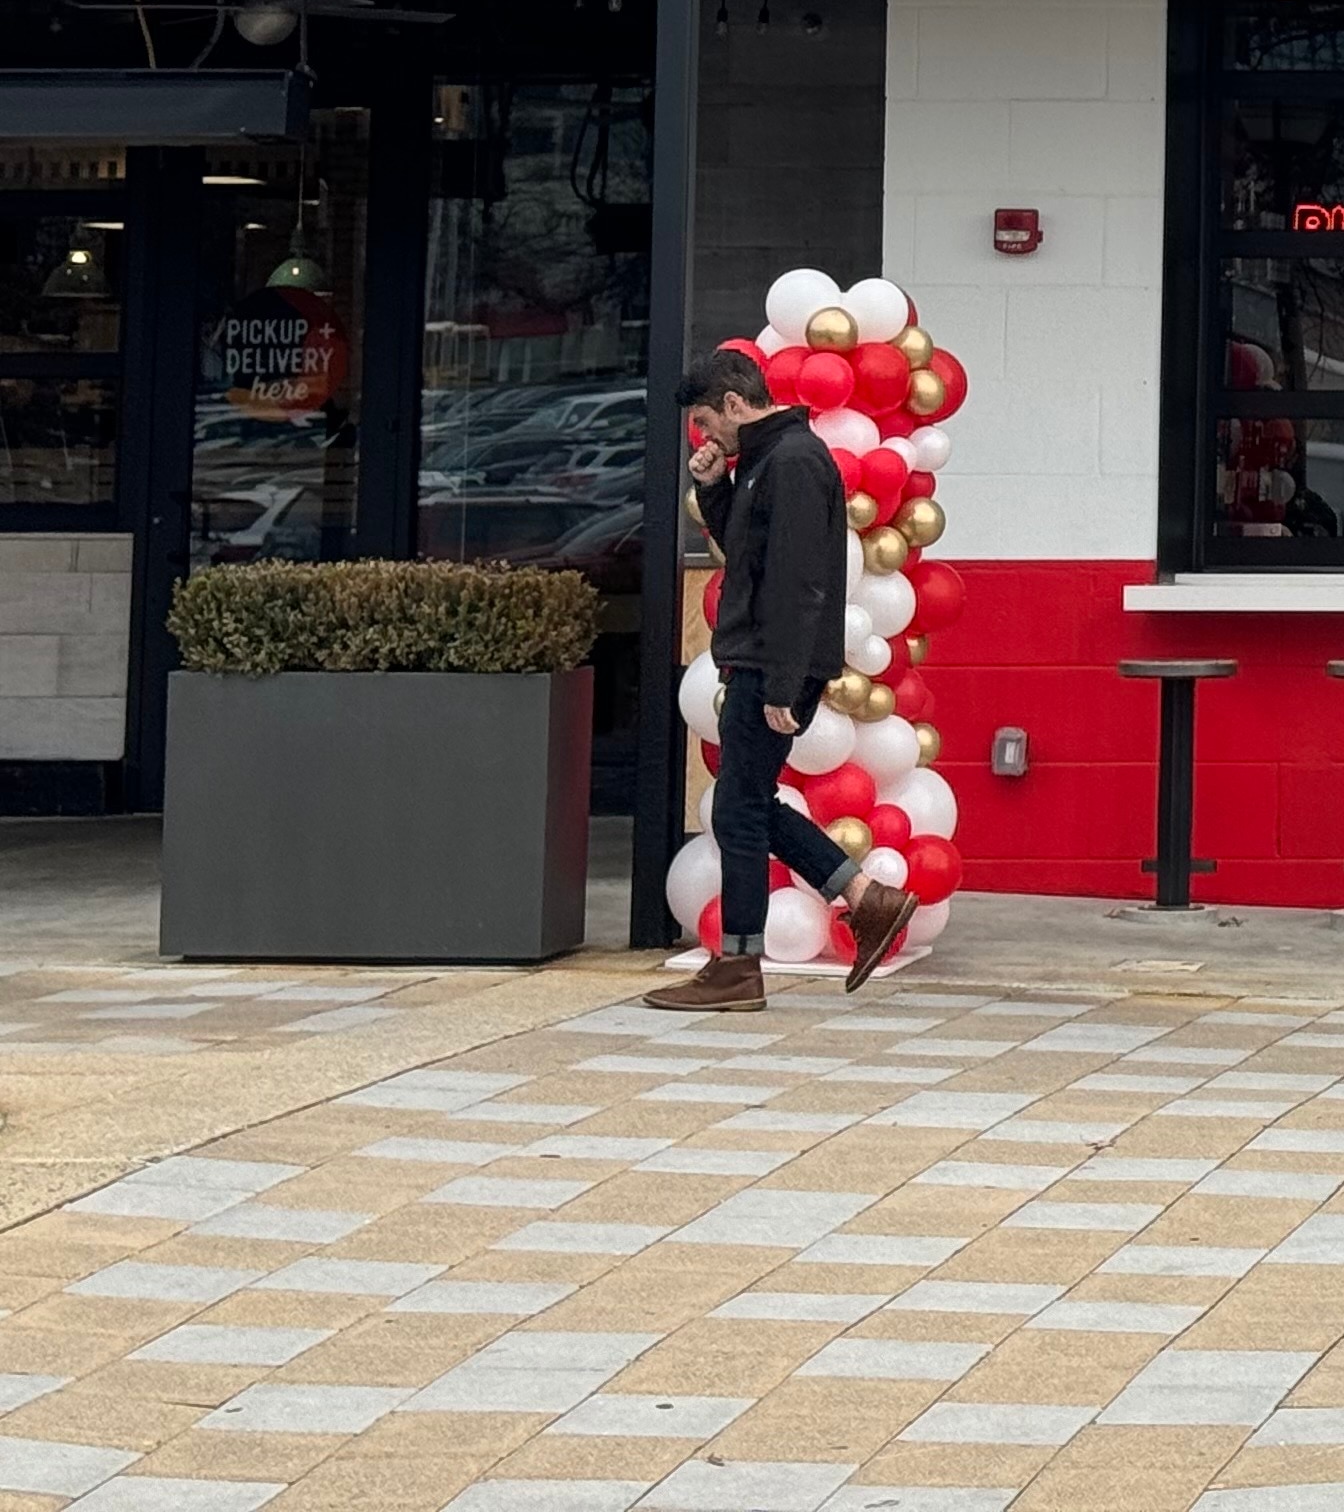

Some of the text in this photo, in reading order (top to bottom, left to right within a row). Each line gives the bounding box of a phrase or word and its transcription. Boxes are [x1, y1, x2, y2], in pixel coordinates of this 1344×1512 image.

[226, 318, 308, 345] PICKUP
[225, 347, 334, 374] DELIVERY
[250, 375, 309, 401] here
